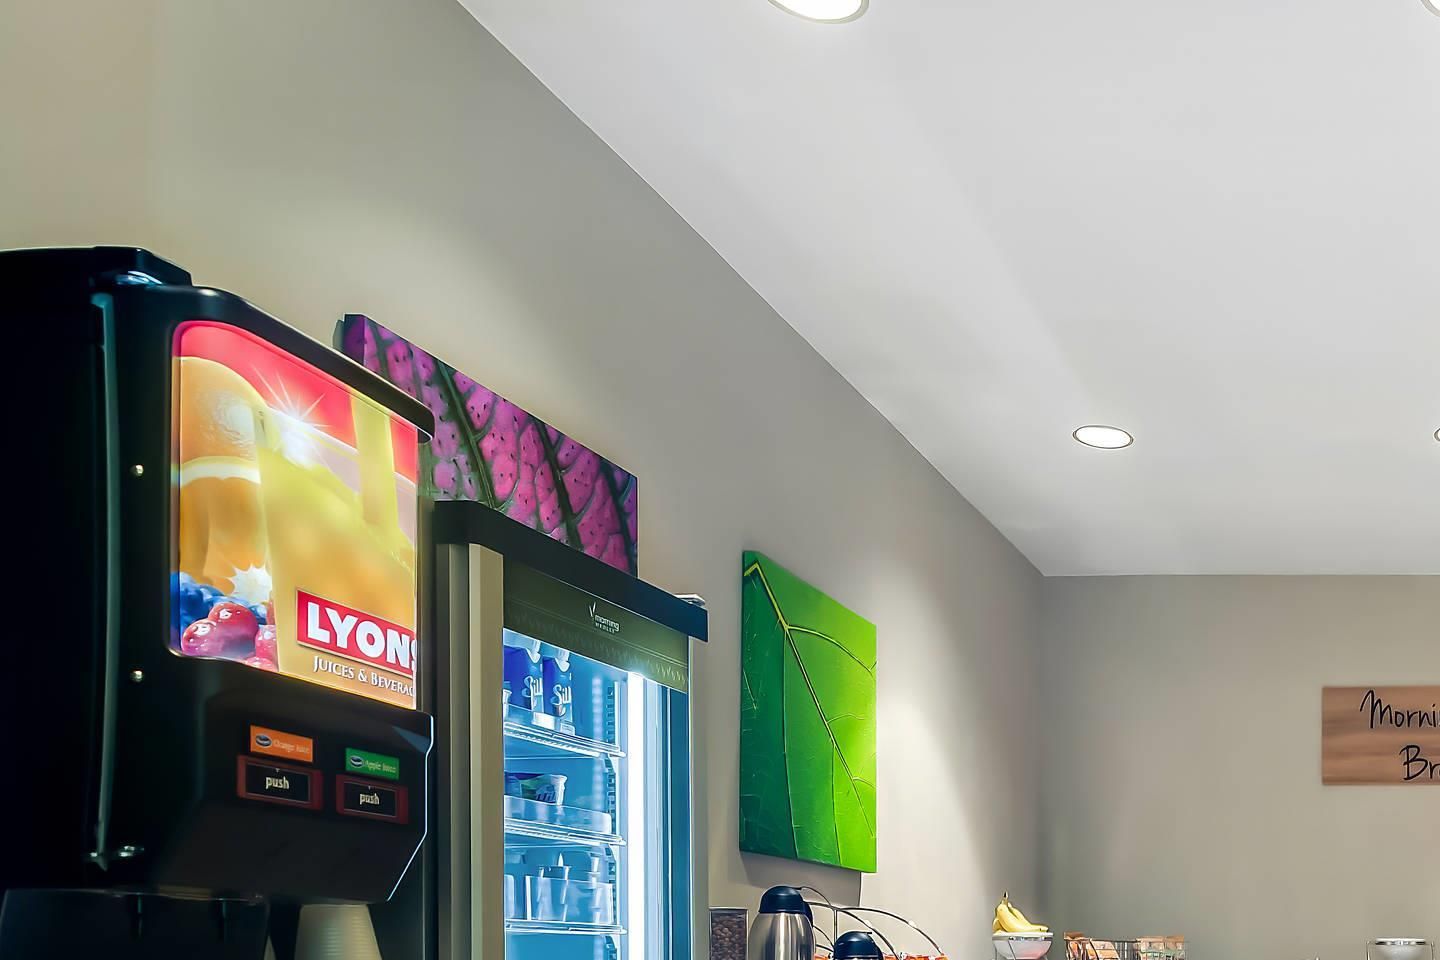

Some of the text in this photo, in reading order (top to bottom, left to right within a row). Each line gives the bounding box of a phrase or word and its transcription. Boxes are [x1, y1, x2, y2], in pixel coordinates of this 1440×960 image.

[313, 655, 355, 679] JUICES
[357, 668, 369, 683] &
[265, 775, 290, 791] push
[359, 792, 380, 806] push
